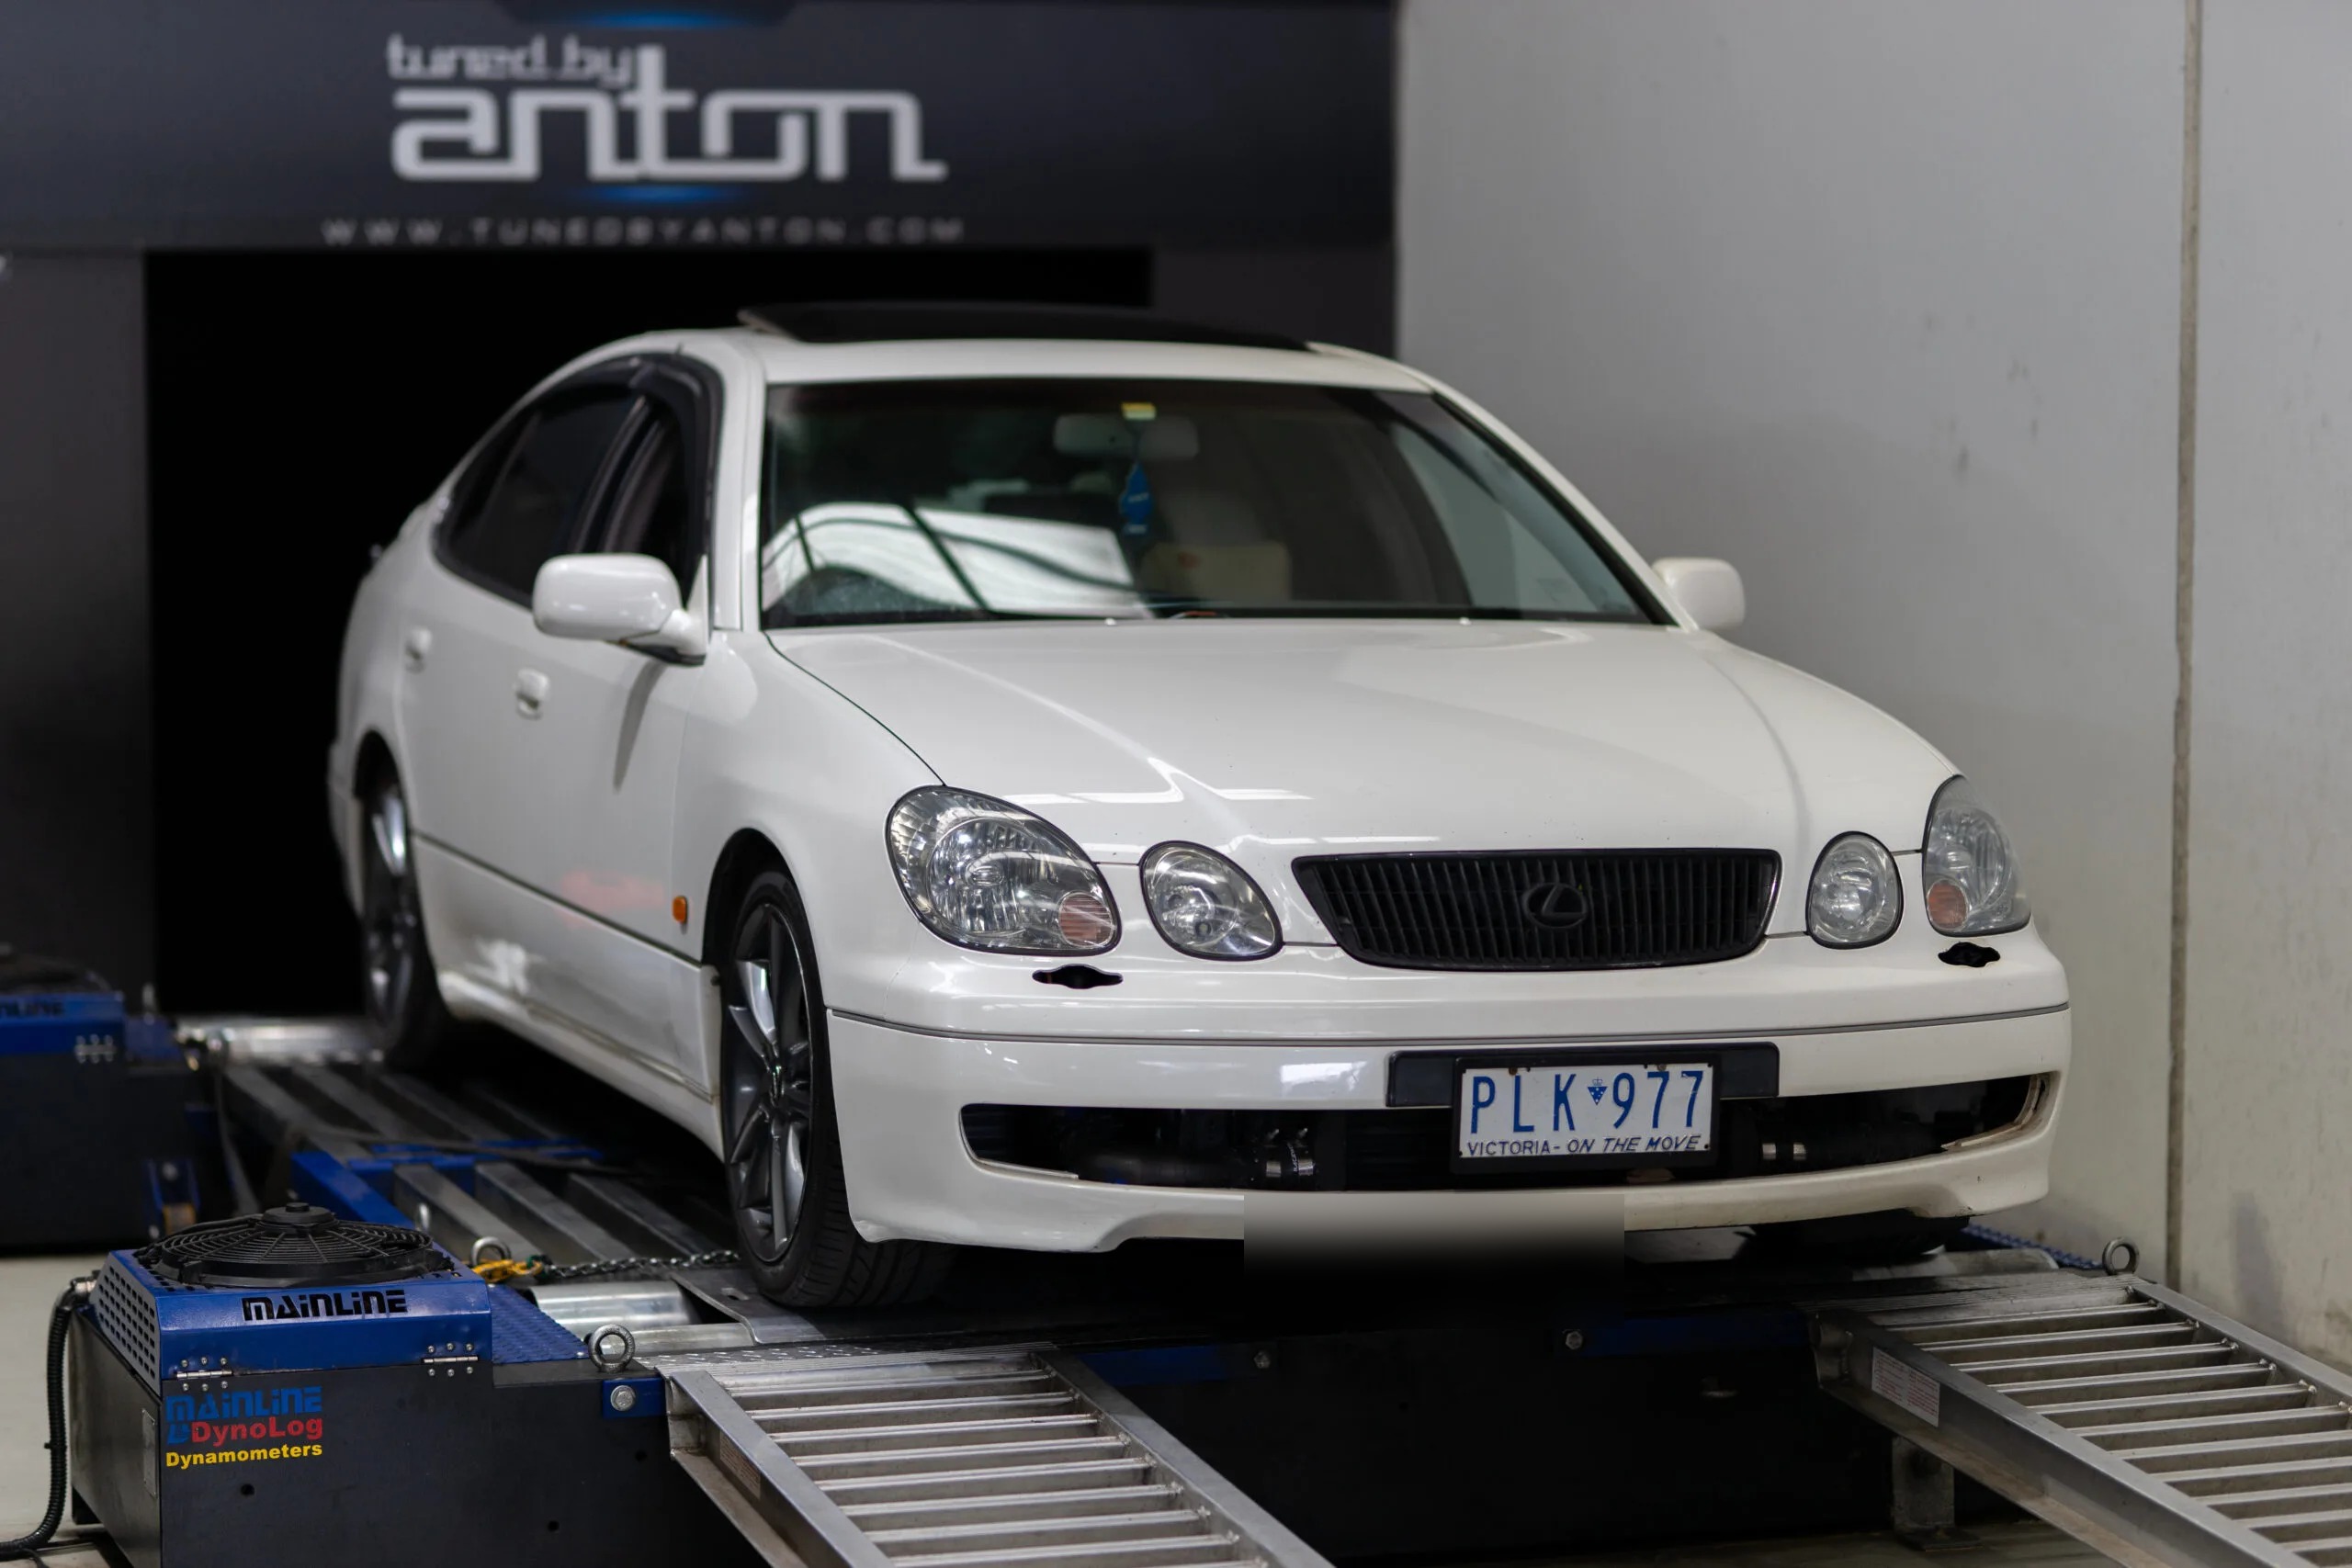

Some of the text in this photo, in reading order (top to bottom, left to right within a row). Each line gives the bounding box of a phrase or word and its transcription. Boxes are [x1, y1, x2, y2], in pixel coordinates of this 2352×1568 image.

[391, 44, 948, 181] anton
[1470, 1070, 1704, 1134] PLK 977
[1566, 1137, 1596, 1153] ON
[1604, 1135, 1642, 1153] THE
[1645, 1134, 1702, 1152] MOVE
[166, 1443, 322, 1470] Dynamometers
